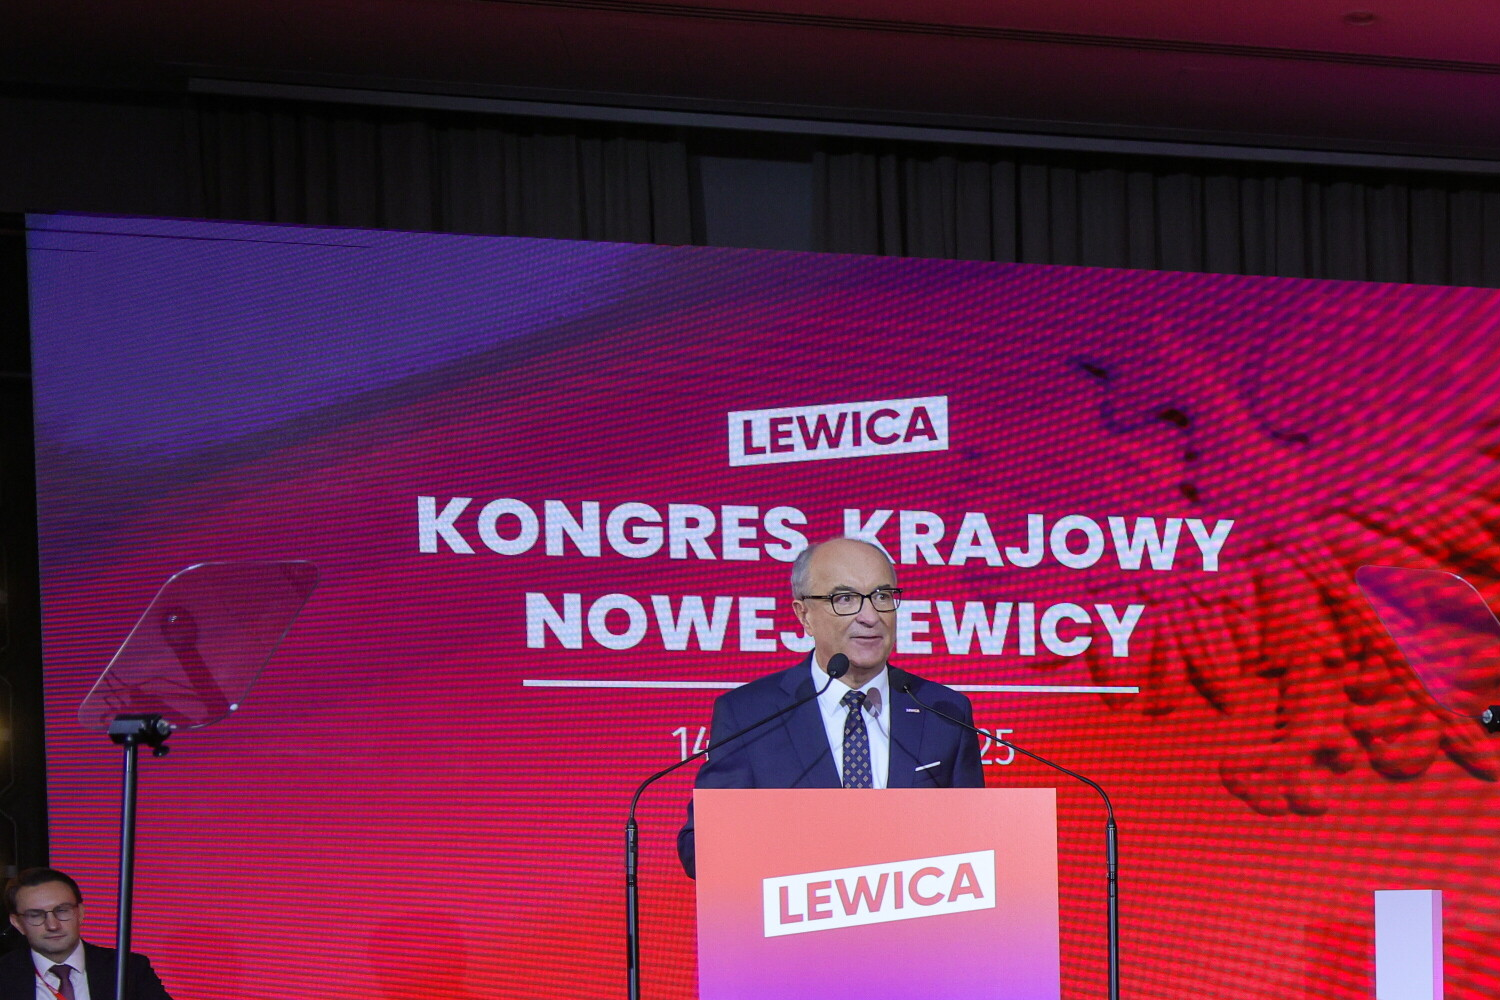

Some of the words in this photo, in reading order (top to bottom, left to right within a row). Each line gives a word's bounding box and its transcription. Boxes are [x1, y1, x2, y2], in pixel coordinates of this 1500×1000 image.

[743, 406, 938, 456] LEWICA
[417, 496, 809, 563] KONGRES
[843, 508, 1235, 573] KRAJOWY
[896, 598, 1144, 659] EWICY
[779, 862, 984, 925] LEWICA
